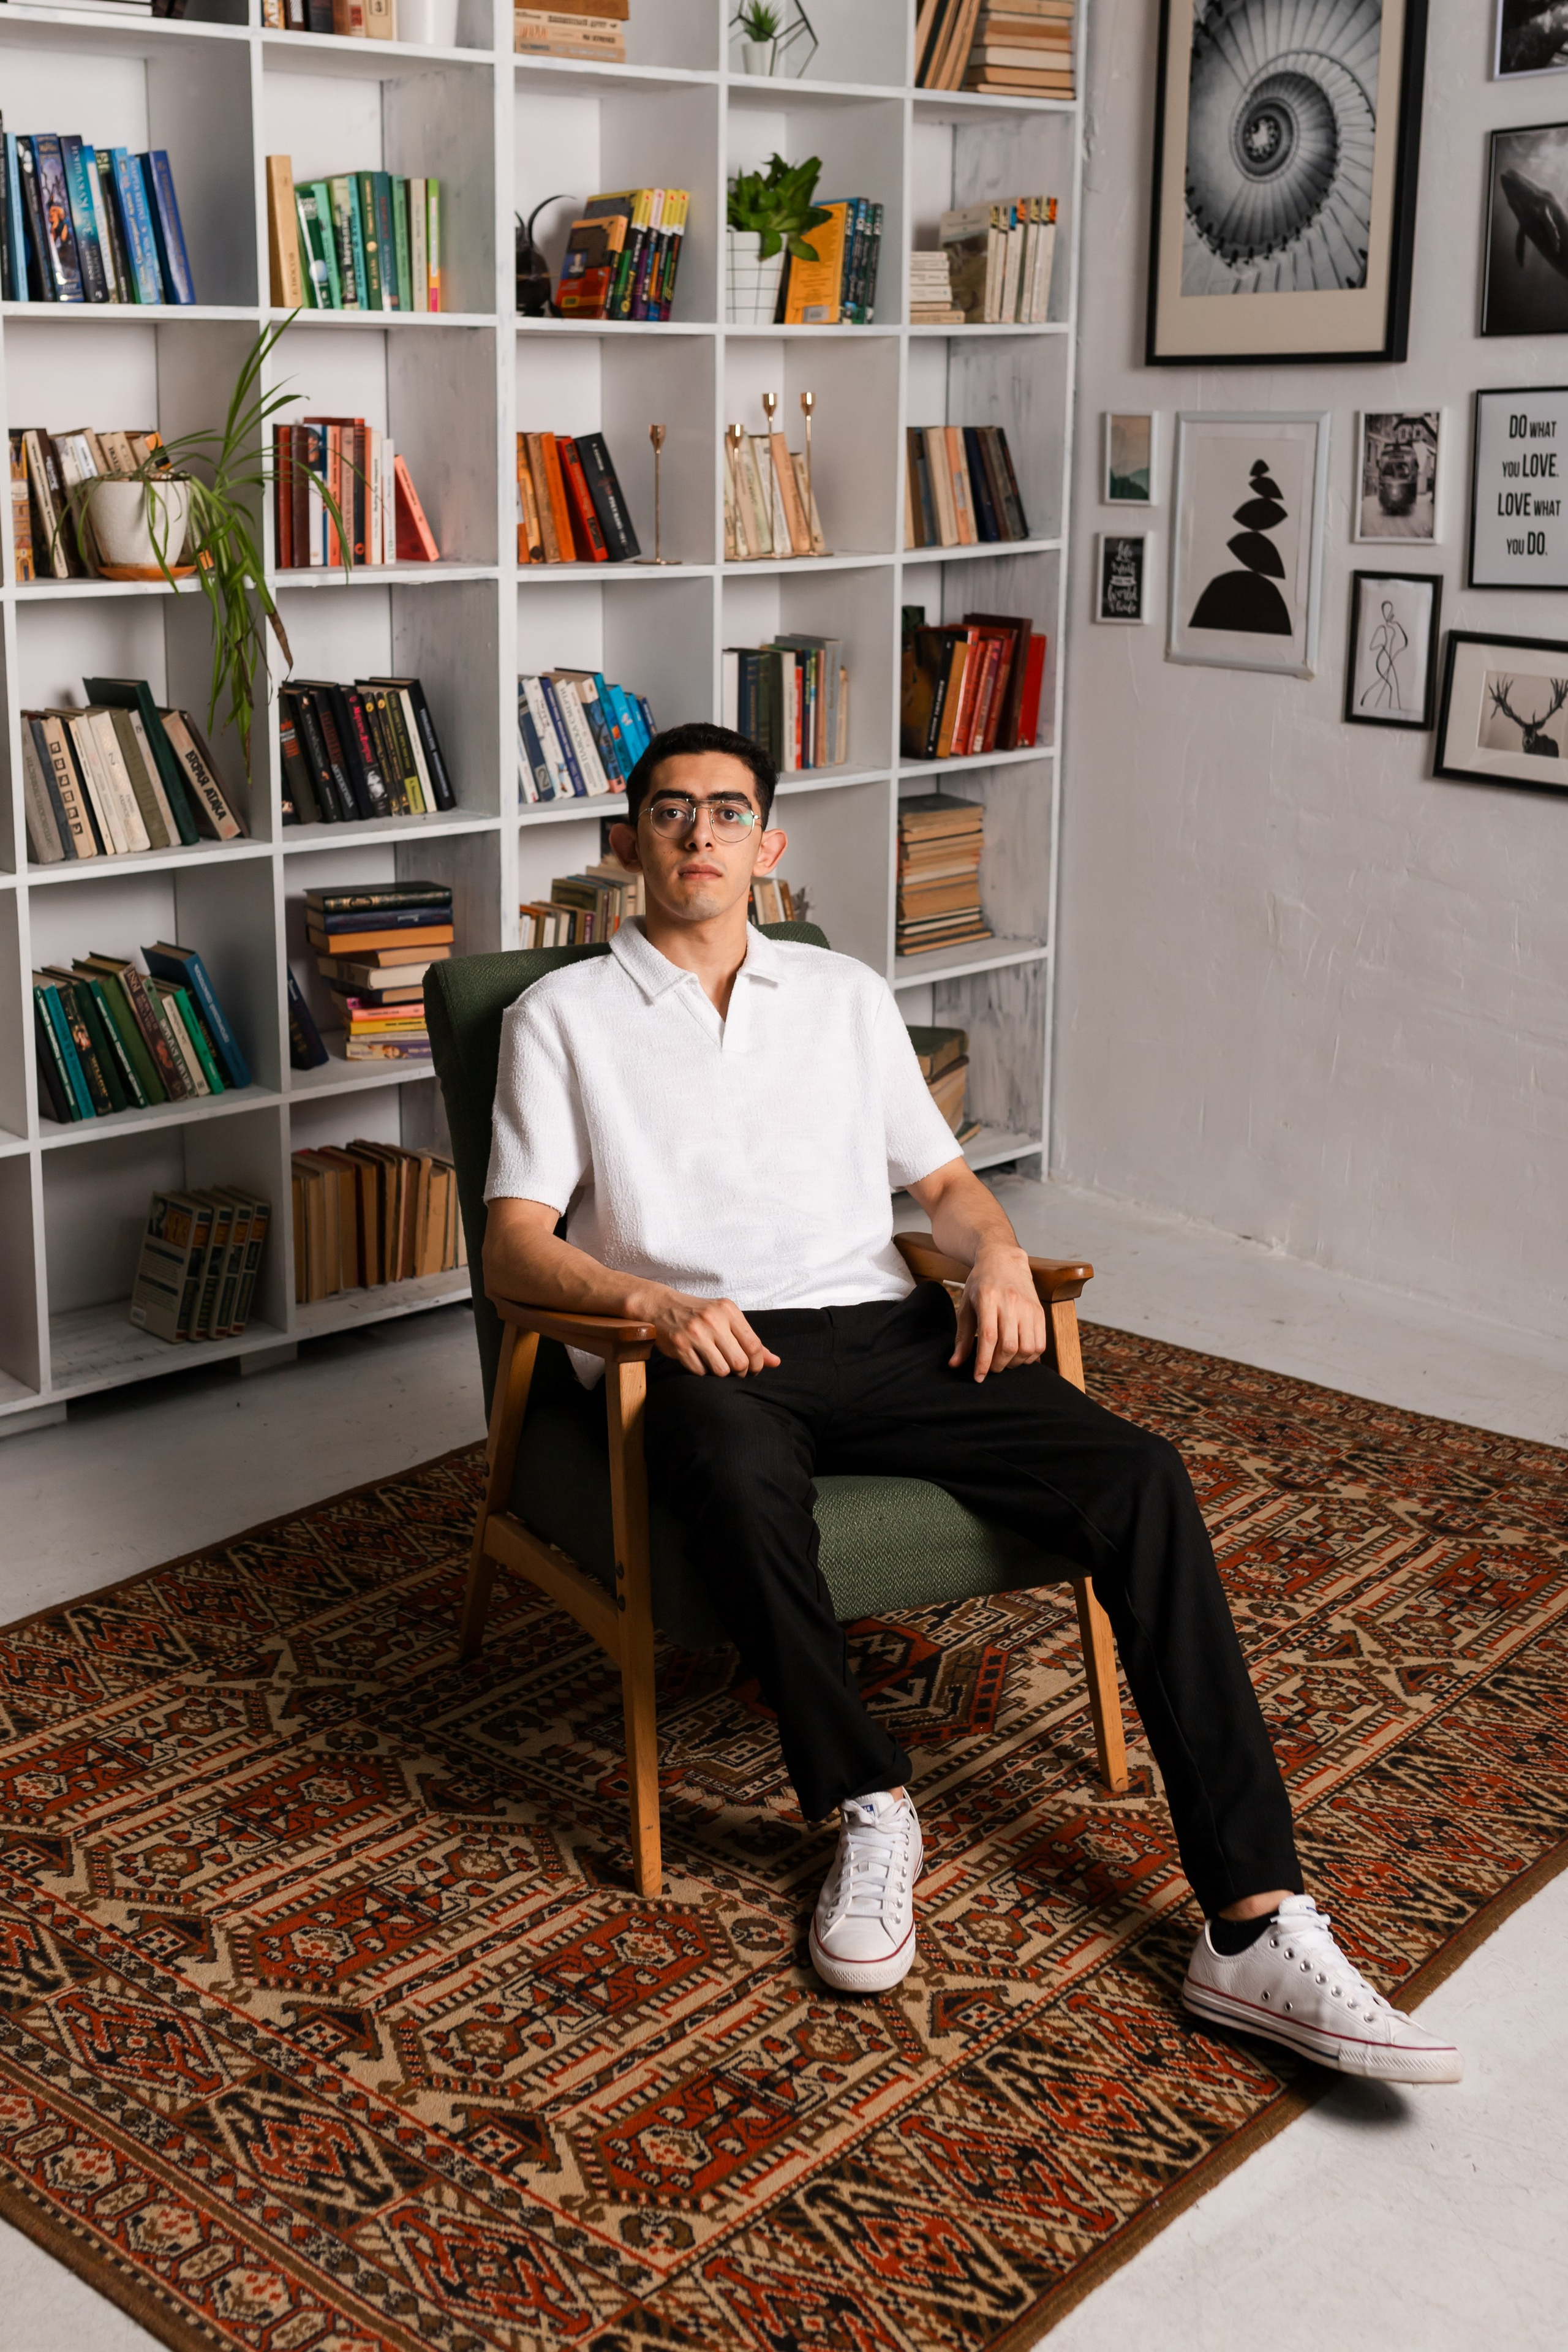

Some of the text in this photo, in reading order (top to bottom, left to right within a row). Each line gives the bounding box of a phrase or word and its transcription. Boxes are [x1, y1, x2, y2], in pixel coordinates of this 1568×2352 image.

[1509, 414, 1557, 439] DO WHAT
[1502, 453, 1559, 478] YOU LOVE.
[1497, 492, 1561, 517] LOVE WHAT
[1506, 531, 1548, 556] YOU DO.
[185, 749, 227, 821] ВТОРАЯ АТАКА
[538, 767, 550, 788] 2
